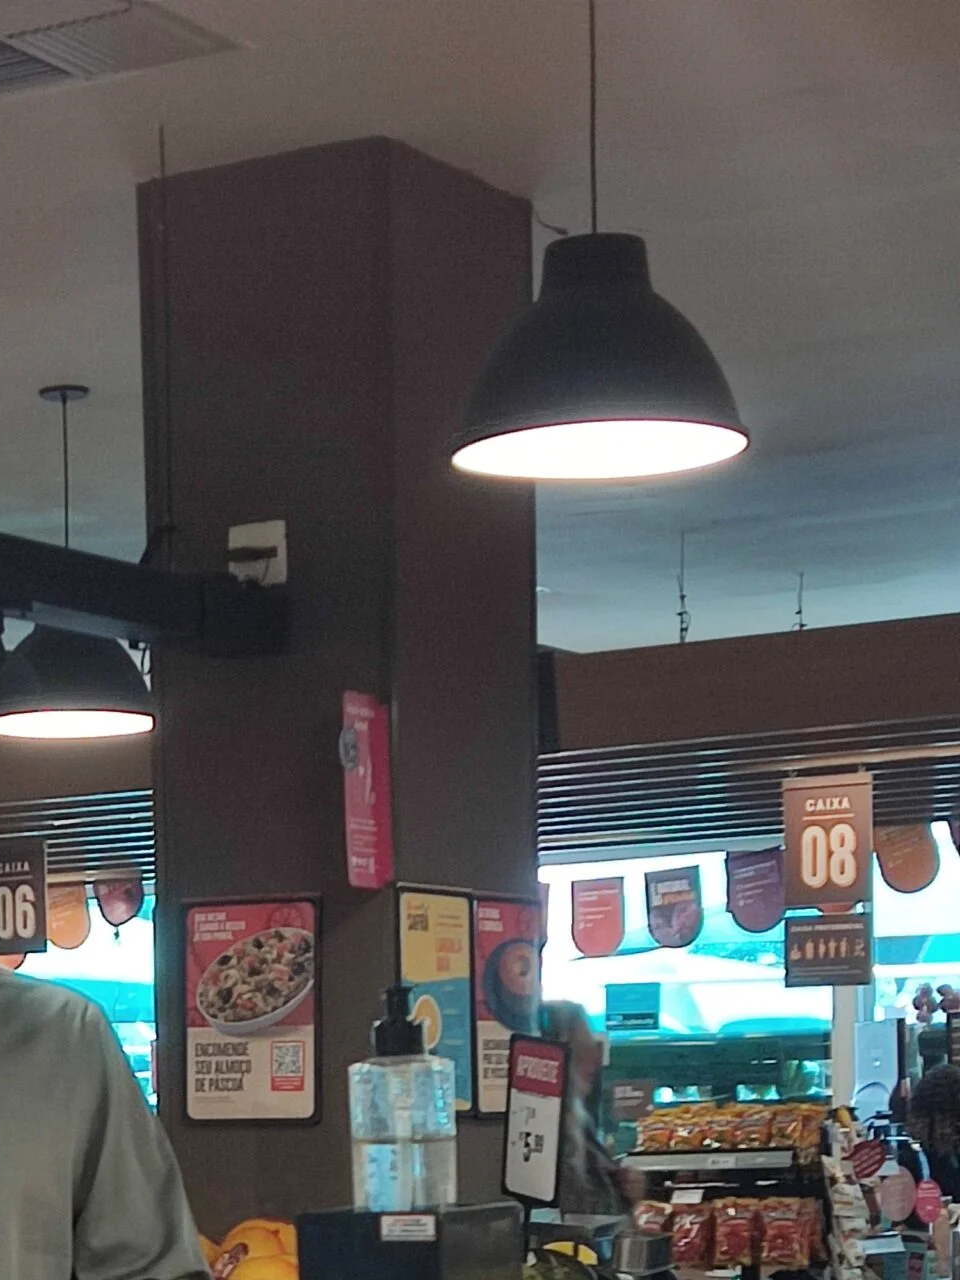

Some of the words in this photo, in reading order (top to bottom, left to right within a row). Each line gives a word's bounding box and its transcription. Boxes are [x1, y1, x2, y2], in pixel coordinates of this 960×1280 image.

[805, 797, 850, 812] CAIXA
[801, 823, 857, 889] 08
[194, 1042, 249, 1057] ENCOMENDE
[194, 1060, 212, 1074] SEU
[214, 1059, 252, 1078] ALMOÇO
[194, 1077, 206, 1092] DE
